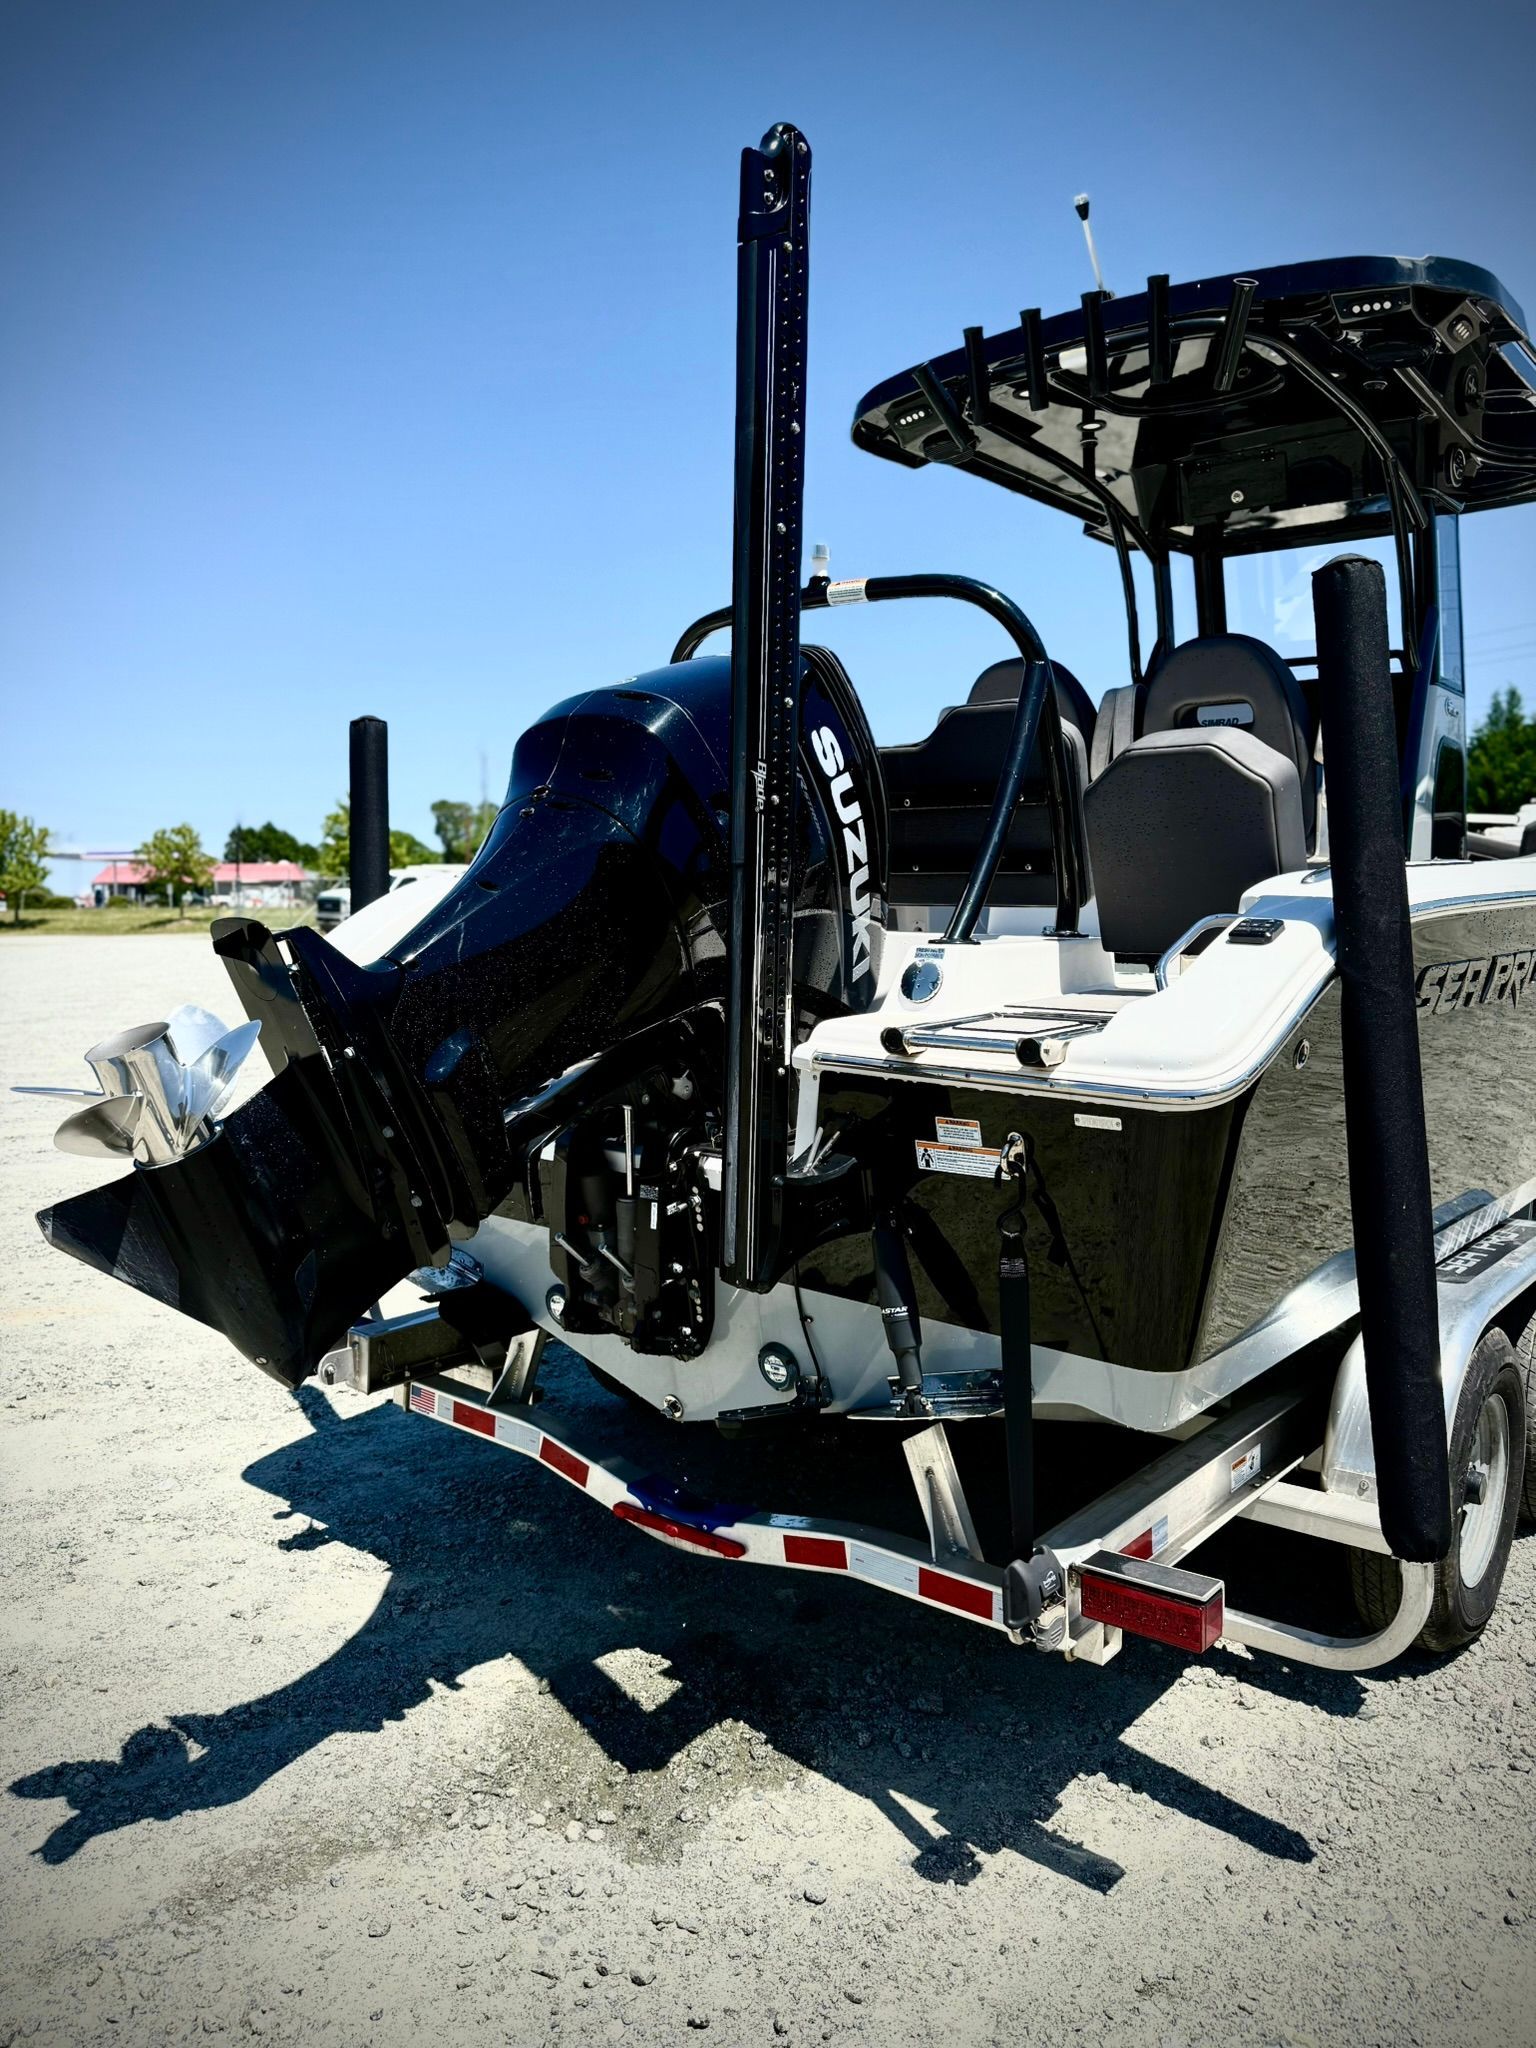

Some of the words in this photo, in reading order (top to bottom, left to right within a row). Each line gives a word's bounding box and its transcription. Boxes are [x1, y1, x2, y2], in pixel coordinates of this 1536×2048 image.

[811, 726, 871, 983] SUZUKI
[1415, 957, 1493, 1018] SEA
[1483, 949, 1536, 1009] PR
[1436, 1251, 1489, 1275] SEA
